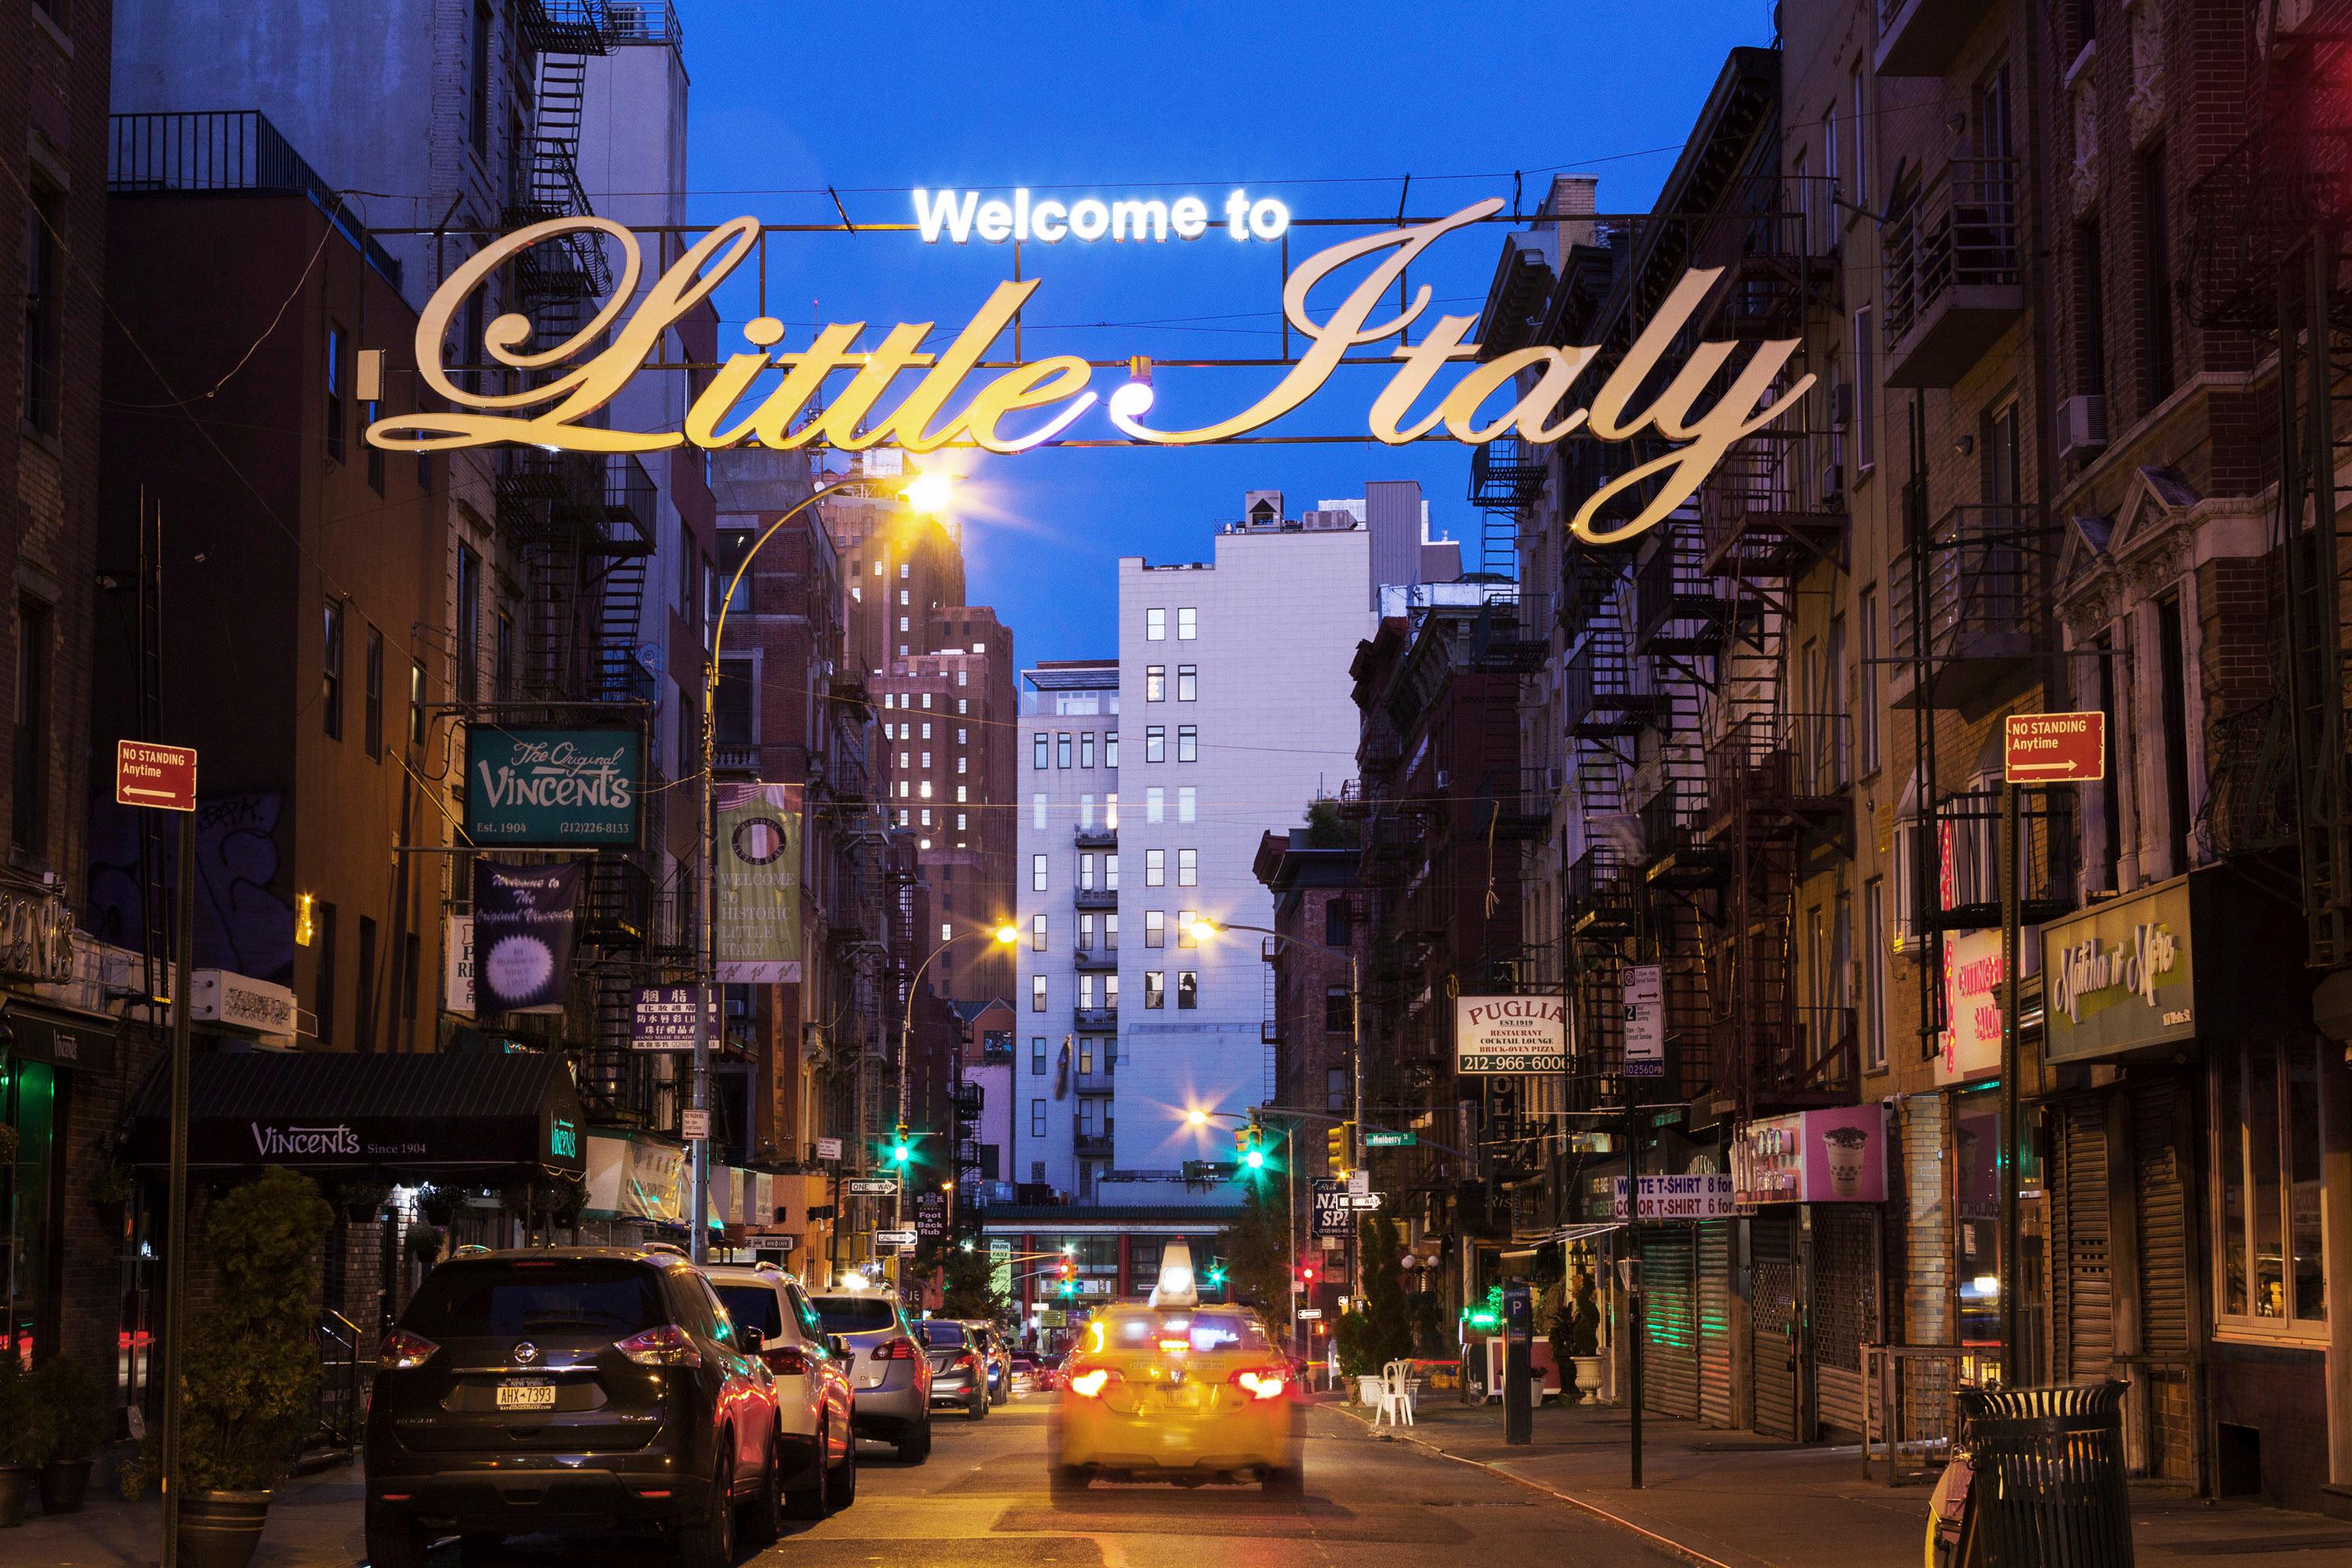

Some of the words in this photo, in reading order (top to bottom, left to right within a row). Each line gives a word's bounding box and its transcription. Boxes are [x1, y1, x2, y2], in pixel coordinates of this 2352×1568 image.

[913, 187, 1207, 245] Welcome
[1226, 188, 1289, 241] to
[365, 215, 1098, 455] Little
[1109, 196, 1817, 546] Italy
[2013, 723, 2027, 735] NO
[2031, 720, 2086, 735] STANDING
[2013, 737, 2059, 752] Anytime
[122, 748, 136, 760] NO
[139, 750, 185, 766] STANDING
[511, 741, 548, 766] The
[551, 741, 625, 777] Original
[122, 763, 162, 777] Anytime
[477, 822, 497, 833] Est.
[501, 822, 527, 833] 1904
[560, 822, 629, 834] (212)226-8133
[548, 877, 560, 888] to
[721, 873, 795, 886] WELCOME
[513, 889, 536, 905] The
[721, 891, 739, 904] TO
[721, 907, 791, 920] HISTORIC
[721, 925, 773, 938] LITTLE
[721, 942, 766, 956] ITALY
[2054, 938, 2110, 1024] Matcha
[2126, 922, 2174, 1007] More
[642, 989, 712, 1003] 胭脂
[1468, 1000, 1564, 1026] PUGLIA
[1627, 1006, 1633, 1019] 2
[1975, 1004, 2002, 1040] SALON
[1464, 1056, 1569, 1070] 212-966-6006
[1625, 1065, 1654, 1074] 102560
[1373, 1134, 1402, 1144] Mulberry
[368, 1144, 397, 1153] Since
[401, 1144, 426, 1153] 1904
[1617, 1178, 1653, 1194] WITE
[1657, 1178, 1701, 1192] T-SHIRT
[1708, 1178, 1714, 1191] 8
[1717, 1178, 1732, 1191] for
[1316, 1193, 1337, 1209] NA
[1616, 1200, 1653, 1215] COOR
[1657, 1200, 1701, 1214] T-SHIRT
[1708, 1200, 1715, 1214] 6
[1717, 1199, 1733, 1213] for
[1512, 1301, 1522, 1315] P
[501, 1388, 519, 1403] AHX
[527, 1388, 551, 1402] 7393
